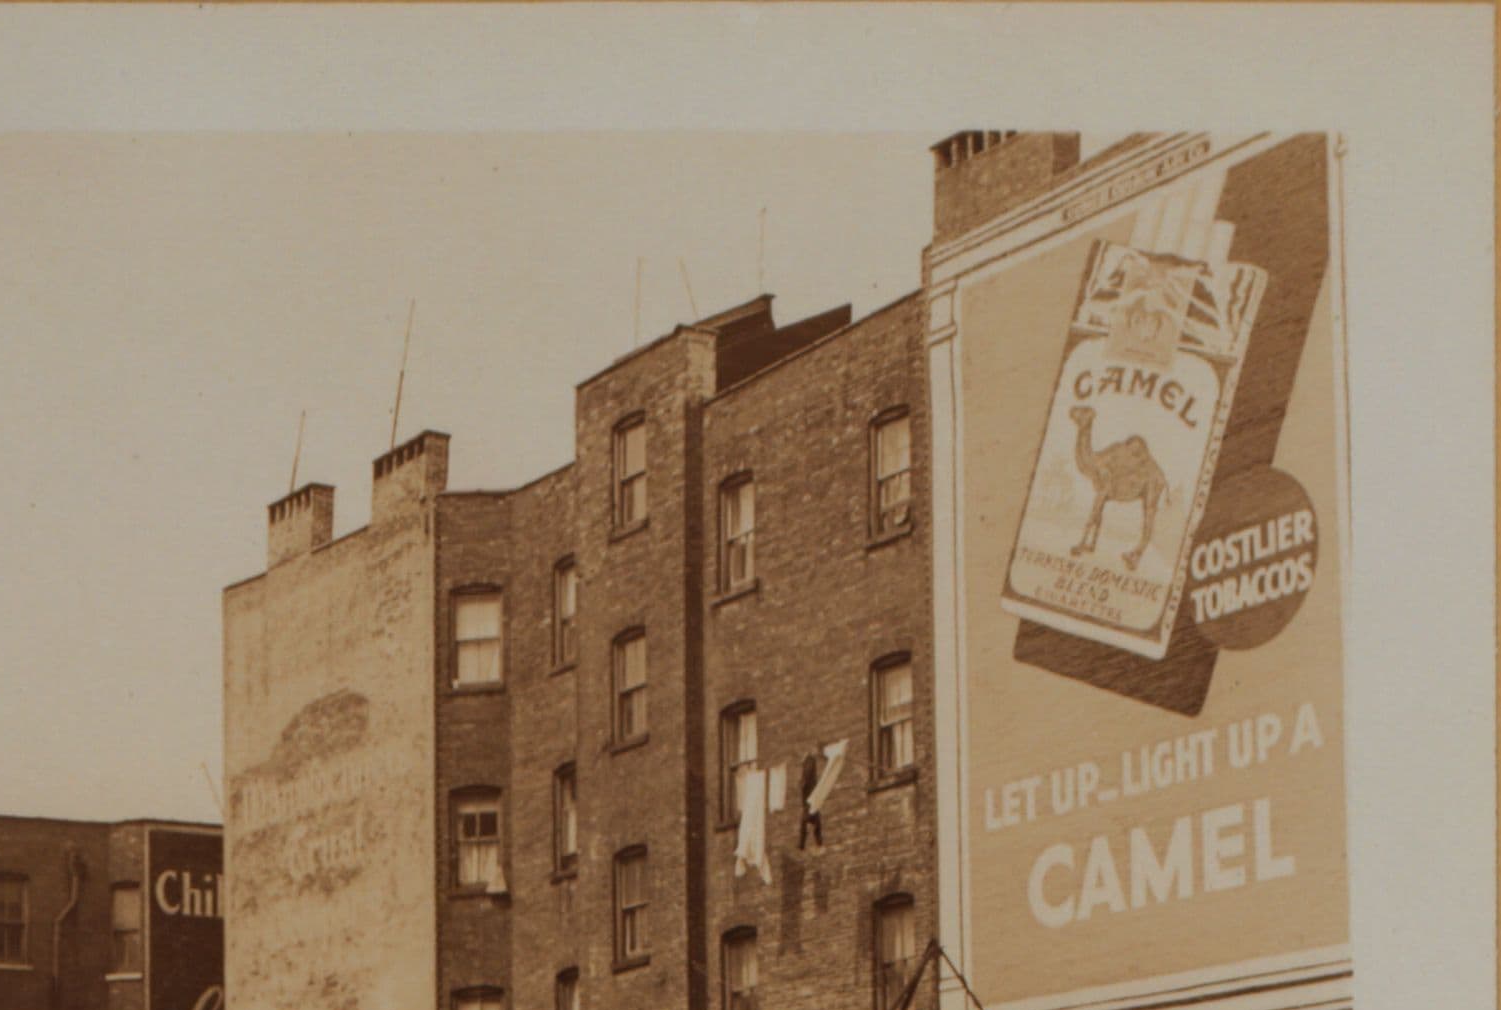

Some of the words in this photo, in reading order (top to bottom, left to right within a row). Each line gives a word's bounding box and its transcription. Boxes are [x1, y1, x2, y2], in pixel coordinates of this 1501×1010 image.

[1073, 366, 1198, 429] CAMEL
[1190, 508, 1314, 581] COSTLIER
[1053, 576, 1111, 604] BLEND
[1087, 566, 1163, 602] DOMESTIC
[1189, 552, 1314, 625] TOBACCOS
[984, 775, 1043, 830] LET
[1050, 762, 1101, 815] UP
[1121, 728, 1219, 797] LIGHT
[1227, 713, 1283, 769] UP
[1289, 700, 1324, 755] A
[1026, 797, 1297, 929] CAMEL
